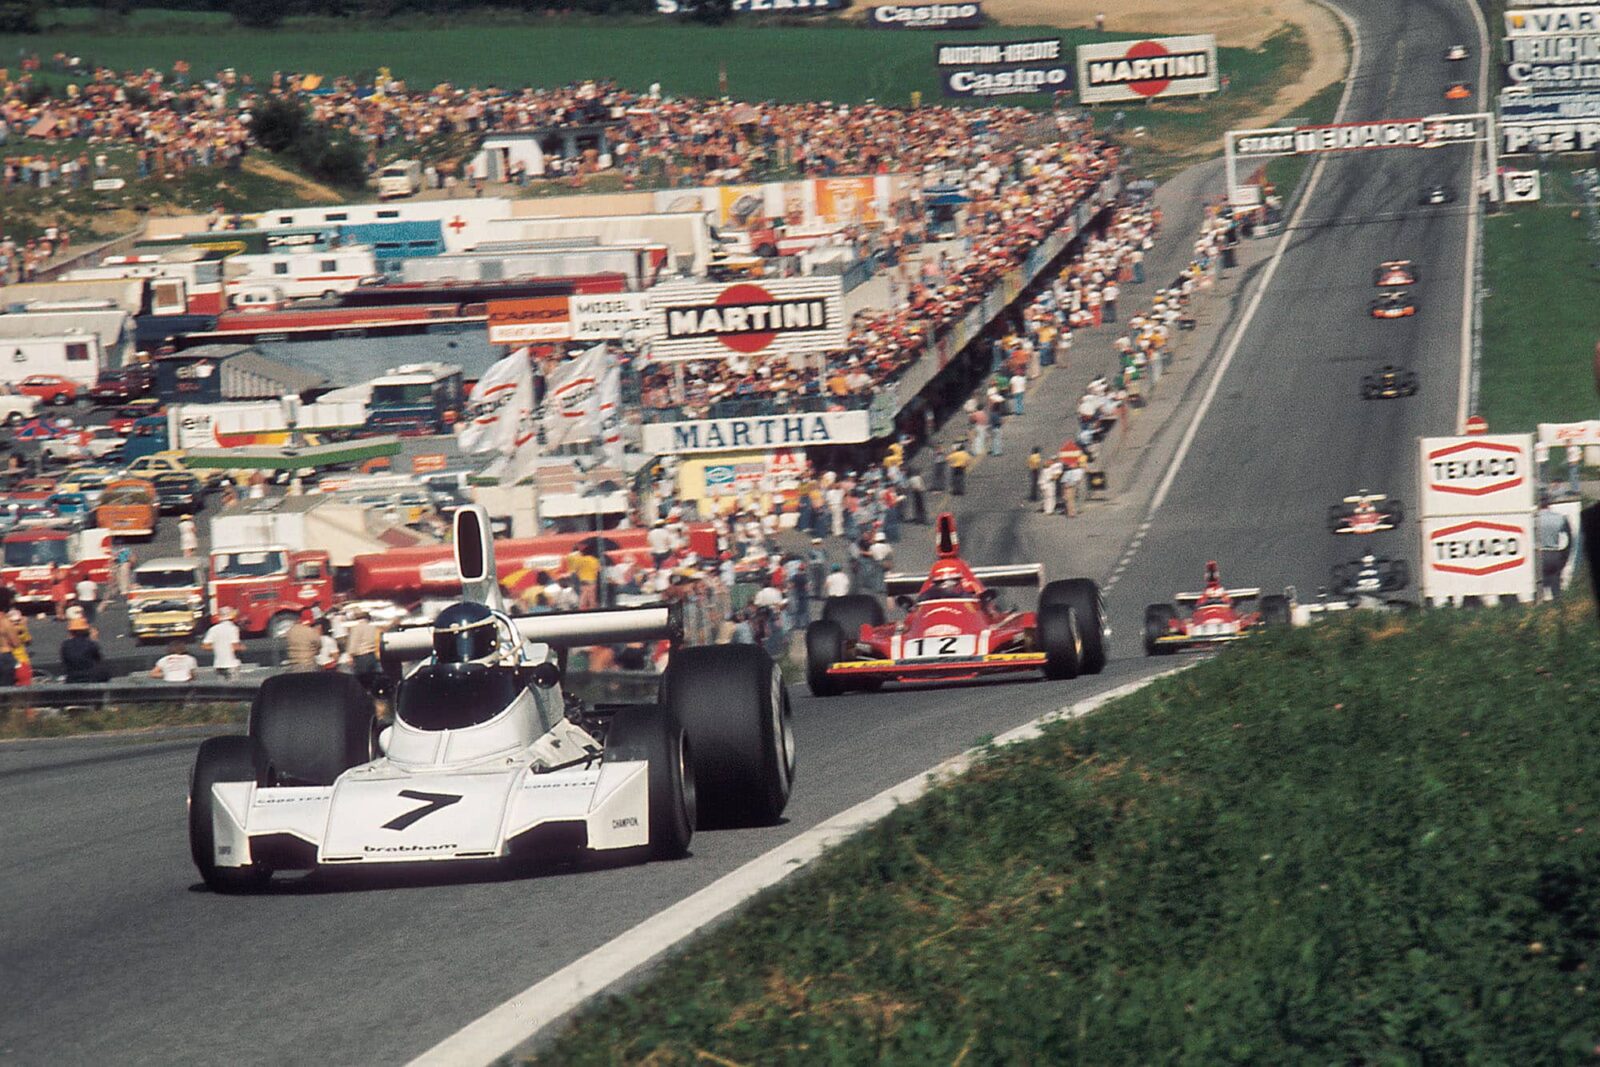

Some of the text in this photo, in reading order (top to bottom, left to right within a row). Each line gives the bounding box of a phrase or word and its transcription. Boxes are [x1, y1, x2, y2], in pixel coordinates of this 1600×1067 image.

[875, 4, 977, 22] Casino
[950, 69, 1067, 91] Casino
[1090, 54, 1206, 83] MARTINI
[1238, 136, 1294, 151] START
[1296, 125, 1422, 151] TEXACO
[670, 302, 825, 334] MARTINI
[673, 416, 832, 449] MARTHA
[1433, 457, 1517, 480] TEXACO
[1436, 537, 1518, 560] TEXACO
[380, 790, 464, 831] 7
[612, 816, 639, 829] CHAMPION
[364, 844, 458, 852] brabham
